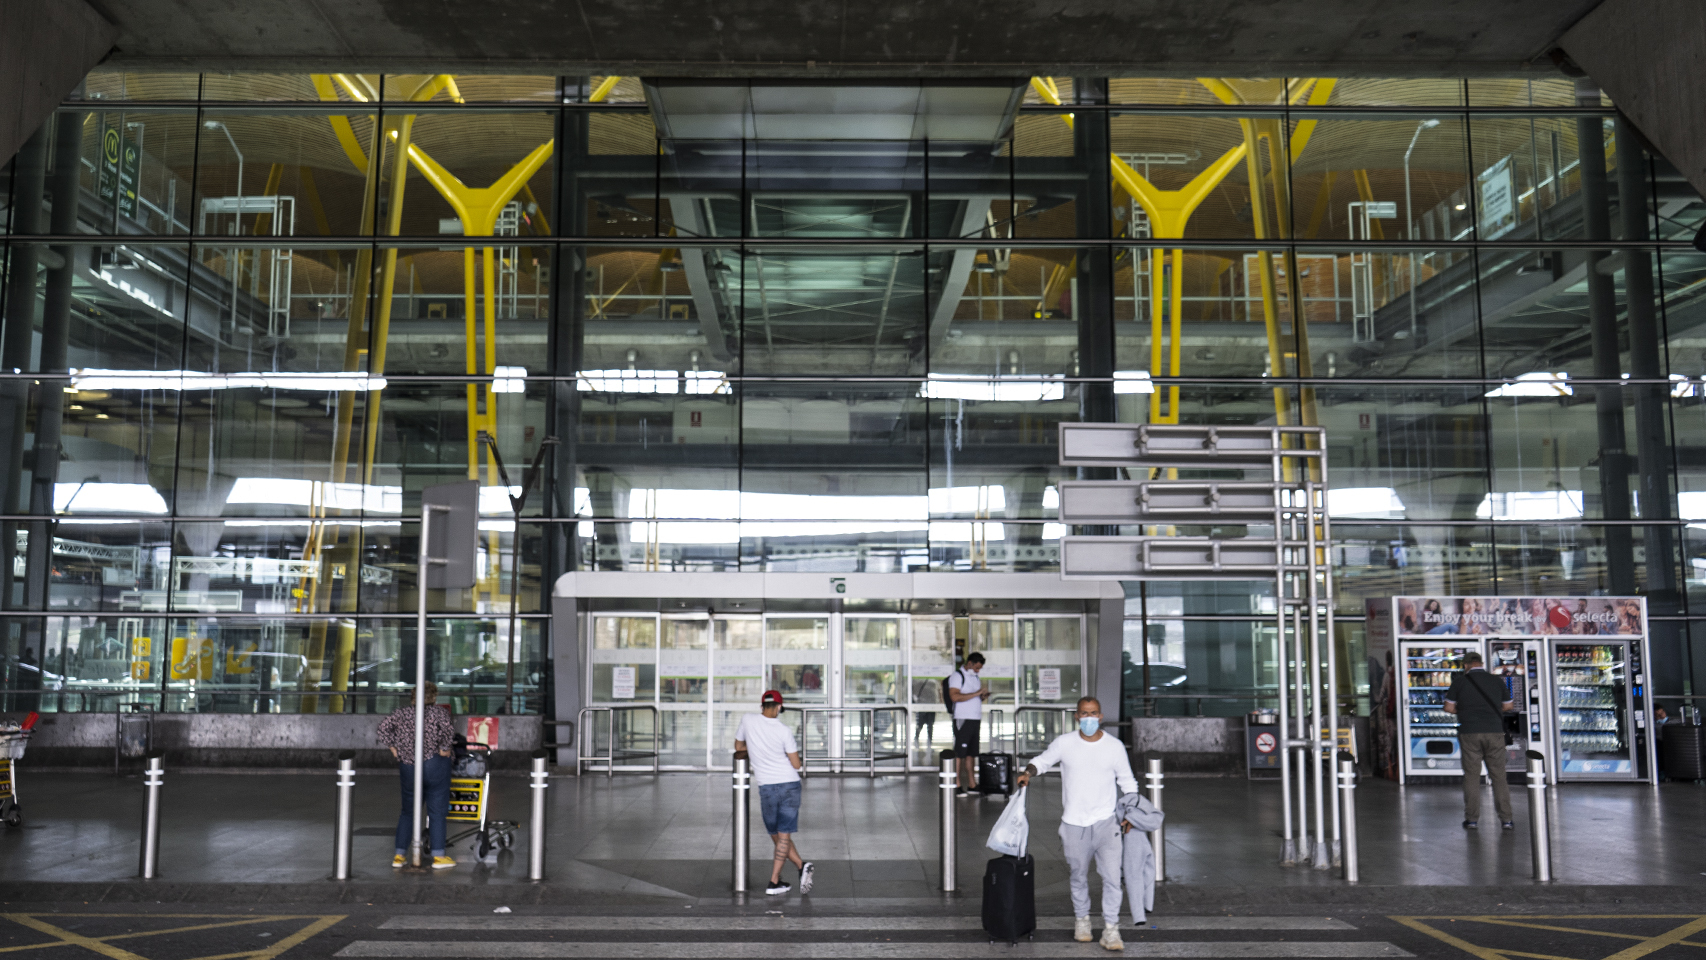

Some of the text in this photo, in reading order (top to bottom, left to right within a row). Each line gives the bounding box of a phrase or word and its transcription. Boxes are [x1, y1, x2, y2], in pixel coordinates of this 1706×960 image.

[1424, 612, 1460, 625] Enjoy
[1463, 613, 1494, 625] your
[1496, 611, 1532, 623] break
[1573, 611, 1618, 623] selecta
